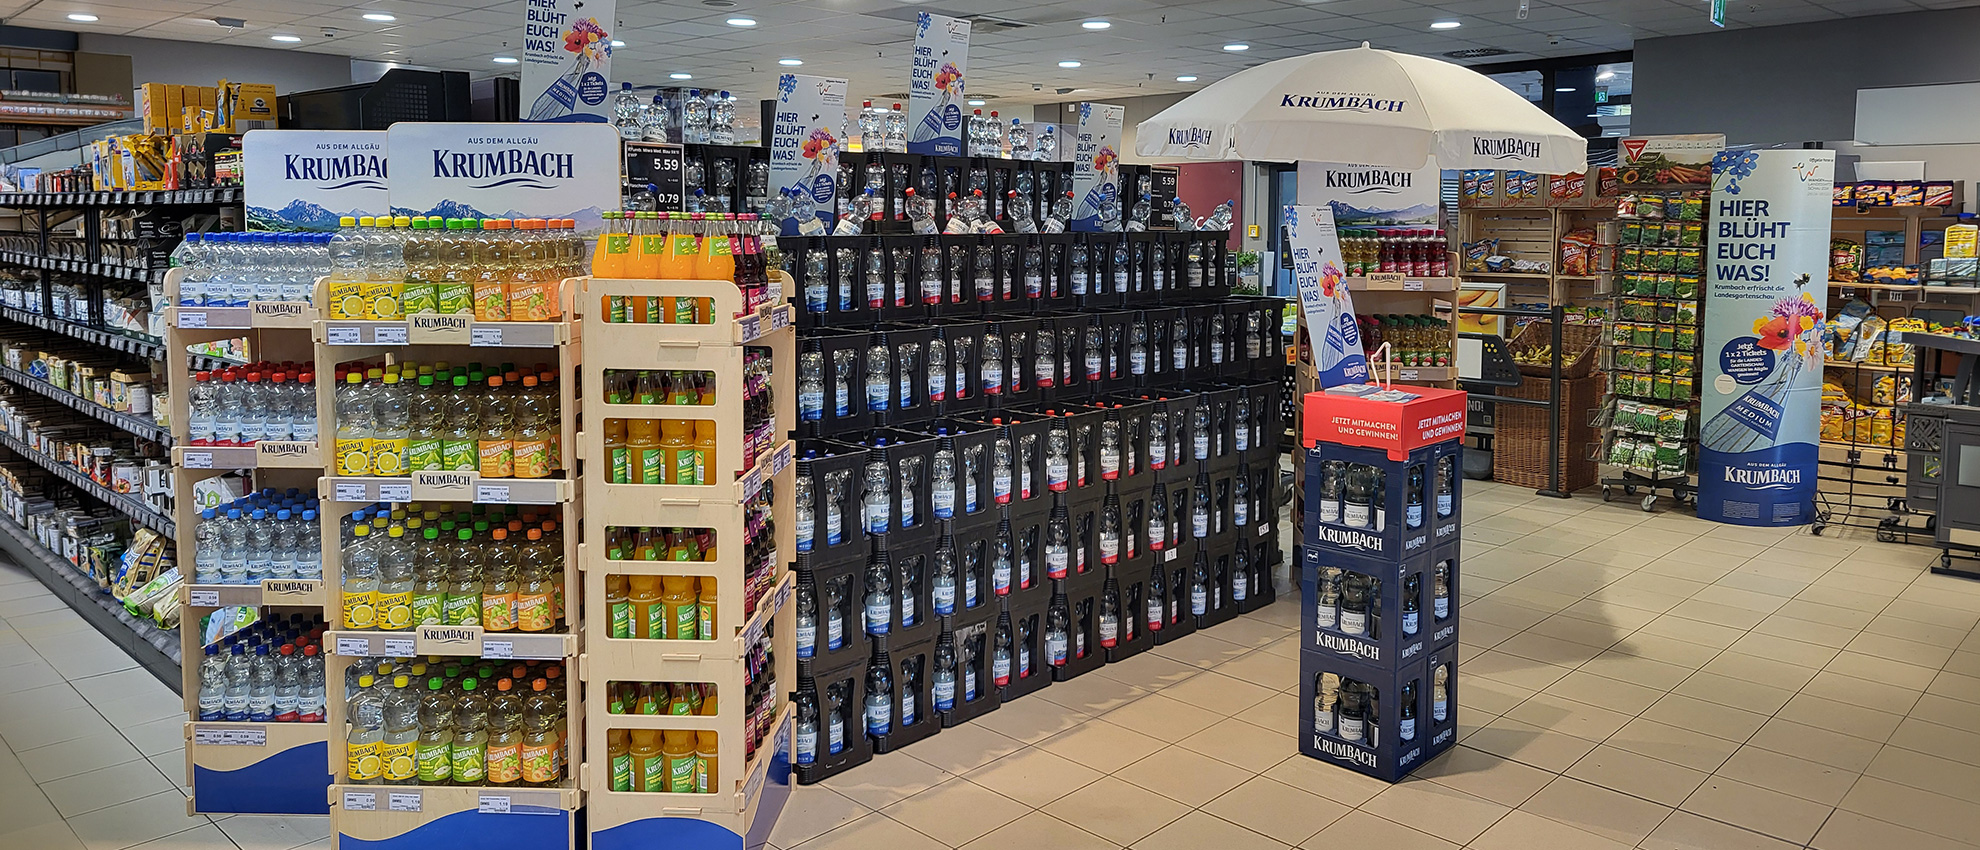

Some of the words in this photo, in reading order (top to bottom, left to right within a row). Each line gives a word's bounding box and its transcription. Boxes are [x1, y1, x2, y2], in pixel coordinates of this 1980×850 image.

[527, 9, 567, 25] BLÜHT
[526, 24, 559, 38] EUCH
[525, 38, 555, 53] WAS!
[915, 45, 932, 56] HIER
[913, 57, 938, 68] BLÜHT
[912, 68, 932, 79] EUCH
[911, 80, 930, 90] WAS!
[1279, 93, 1405, 113] KRUMBACH
[777, 112, 798, 123] HIER
[775, 123, 806, 135] BLÜHT
[467, 137, 484, 145] AUS
[505, 137, 539, 145] ALLGÄU
[774, 137, 799, 148] EUCH
[1078, 133, 1092, 142] HIER
[1077, 142, 1097, 152] BLÜHT
[1472, 136, 1541, 159] KRUMBACH
[772, 150, 796, 160] WAS!
[1076, 154, 1093, 162] EUCH
[284, 153, 388, 181] KRUMBAC
[432, 149, 574, 179] KRUMBACH
[653, 158, 679, 171] 5.59
[1075, 163, 1090, 172] WAS!
[1325, 170, 1412, 188] KRUMBACH
[658, 193, 679, 203] 0.79
[1719, 200, 1769, 217] HIER
[1718, 217, 1791, 238] BLÜHT
[1293, 248, 1310, 260] HIER
[1717, 243, 1776, 260] EUCH
[1296, 260, 1318, 274] BLÜHT
[1716, 264, 1770, 282] WAS!
[1300, 275, 1318, 288] EUCH
[1370, 274, 1401, 282] KRUMBACH
[1747, 284, 1774, 292] erfrischt
[1302, 291, 1319, 303] WAS!
[1714, 292, 1775, 300] Landesgartenschau
[255, 304, 302, 314] KRUMBACH
[414, 316, 466, 329] KRUMBACH
[1737, 343, 1754, 351] Jetzt
[1343, 365, 1367, 378] KRUMBACH
[1742, 394, 1780, 419] KRUMBACH
[1418, 417, 1432, 430] JETZT
[1432, 410, 1462, 426] MITMACHEN
[1735, 404, 1773, 428] MEDIUM
[1331, 416, 1351, 426] JETZT
[1352, 419, 1397, 431] MITMACHEN
[1338, 427, 1354, 435] UND
[1355, 428, 1399, 441] GEWINNEN!
[1422, 431, 1435, 440] UND
[1435, 422, 1463, 438] GEWINNEN!
[261, 443, 307, 454] KRUMBACH
[419, 474, 471, 486] KRUMBACH
[1724, 466, 1801, 485] KRUMBACH
[1436, 523, 1456, 538] KRUMBACH
[1319, 525, 1383, 551] KRUMBACH
[1405, 535, 1427, 550] KRUMBACH
[267, 582, 313, 593] KRUMBACH
[423, 629, 475, 641] KRUMBACH
[1433, 625, 1454, 642] KRUMBACH
[1315, 630, 1380, 661] KRUMBACH
[1401, 641, 1423, 659] KRUMBACH
[1432, 727, 1453, 746] KRUMBACH
[1313, 734, 1378, 768] KRUMBACH
[1399, 747, 1421, 767] KRUMBACH
